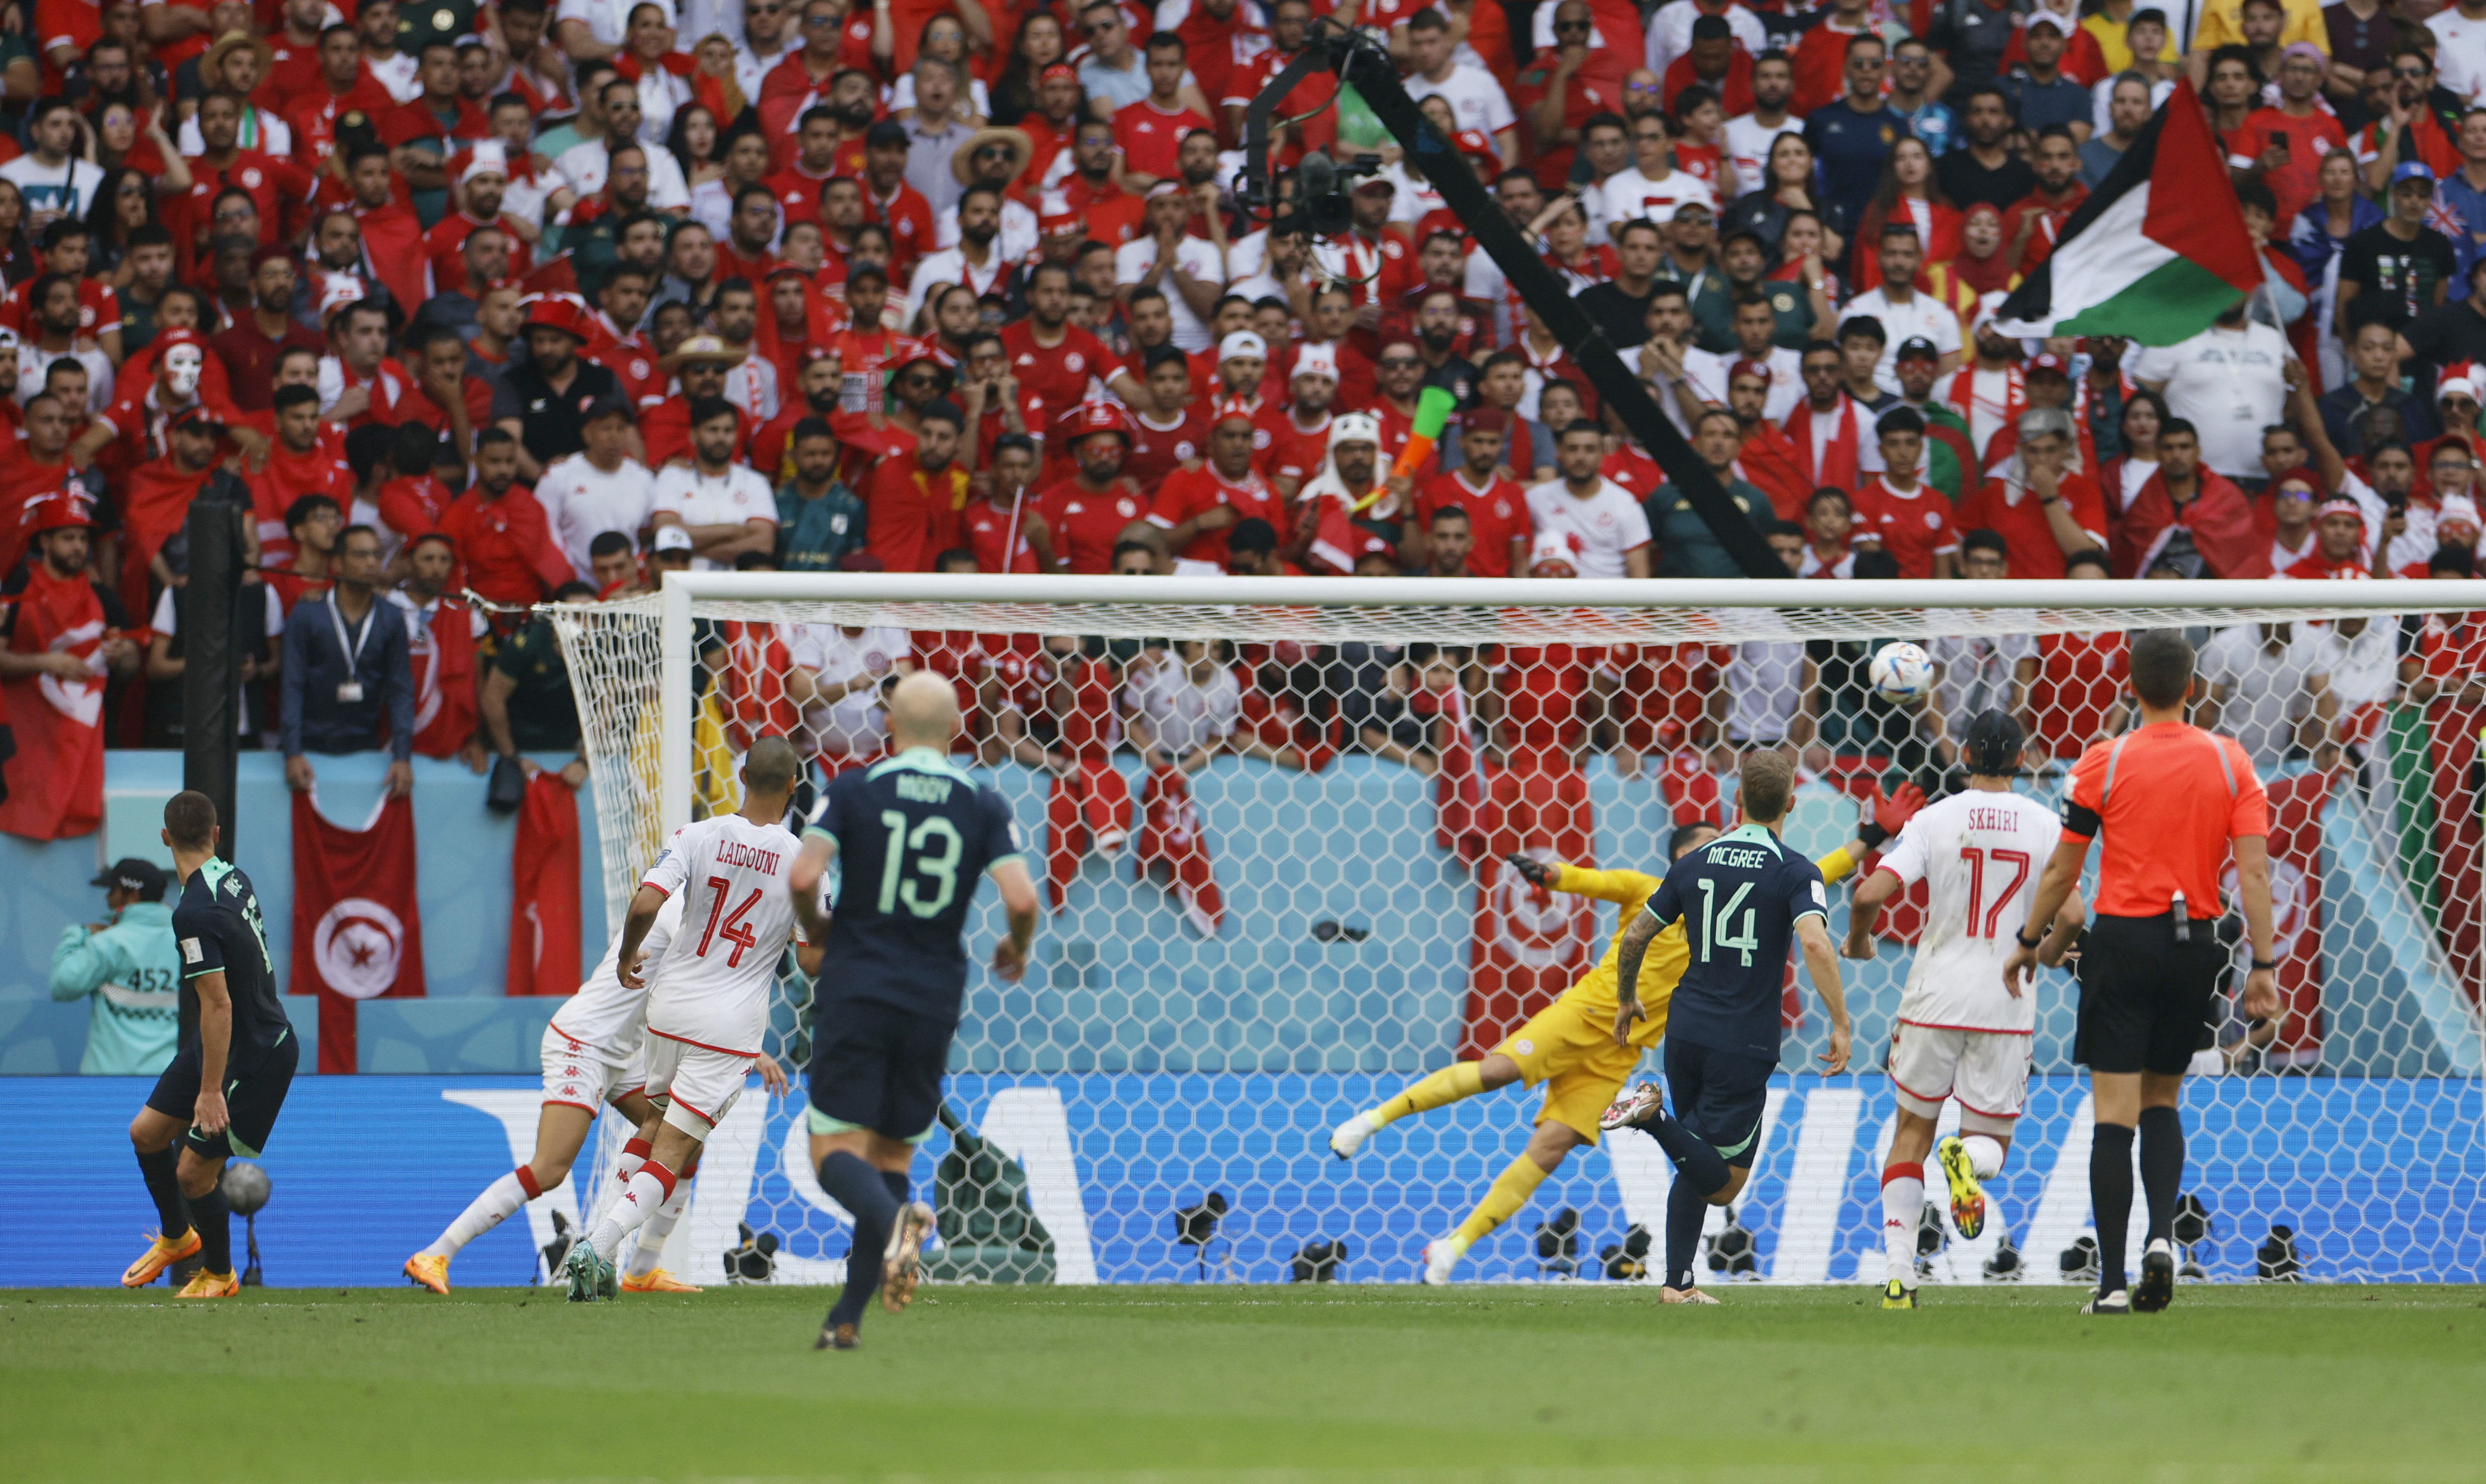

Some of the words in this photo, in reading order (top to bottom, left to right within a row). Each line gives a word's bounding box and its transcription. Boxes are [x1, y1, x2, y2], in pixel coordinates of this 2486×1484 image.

[1969, 807, 2018, 832] SKHIRI
[716, 839, 781, 876] LAIDOUNI
[877, 808, 964, 919] 13
[1706, 846, 1768, 869] MCGREE
[696, 876, 763, 969] 14
[1698, 878, 1758, 967] 14
[1960, 847, 2030, 940] 17
[128, 968, 174, 992] 452
